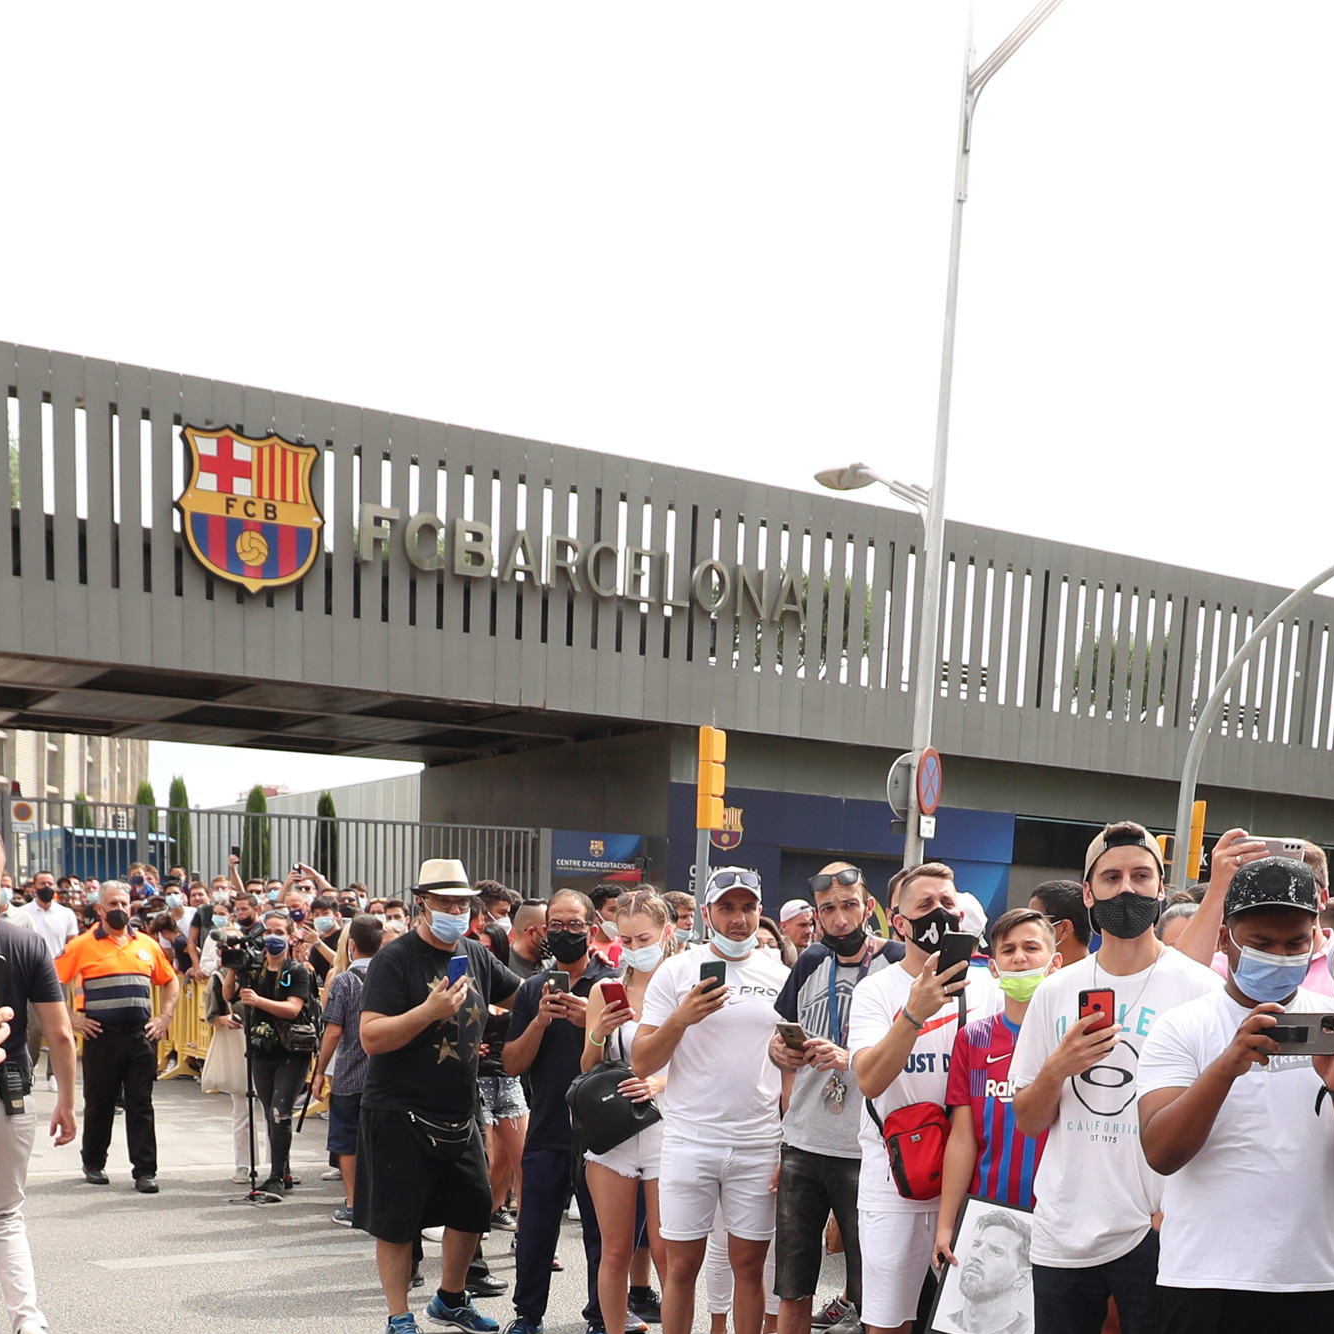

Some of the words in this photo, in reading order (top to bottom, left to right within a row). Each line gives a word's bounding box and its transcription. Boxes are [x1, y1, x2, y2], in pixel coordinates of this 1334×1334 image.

[225, 497, 277, 521] FCB
[556, 858, 581, 867] CENTRE
[739, 986, 778, 997] PRO
[903, 1053, 936, 1073] UST
[985, 1079, 1017, 1097] Rak
